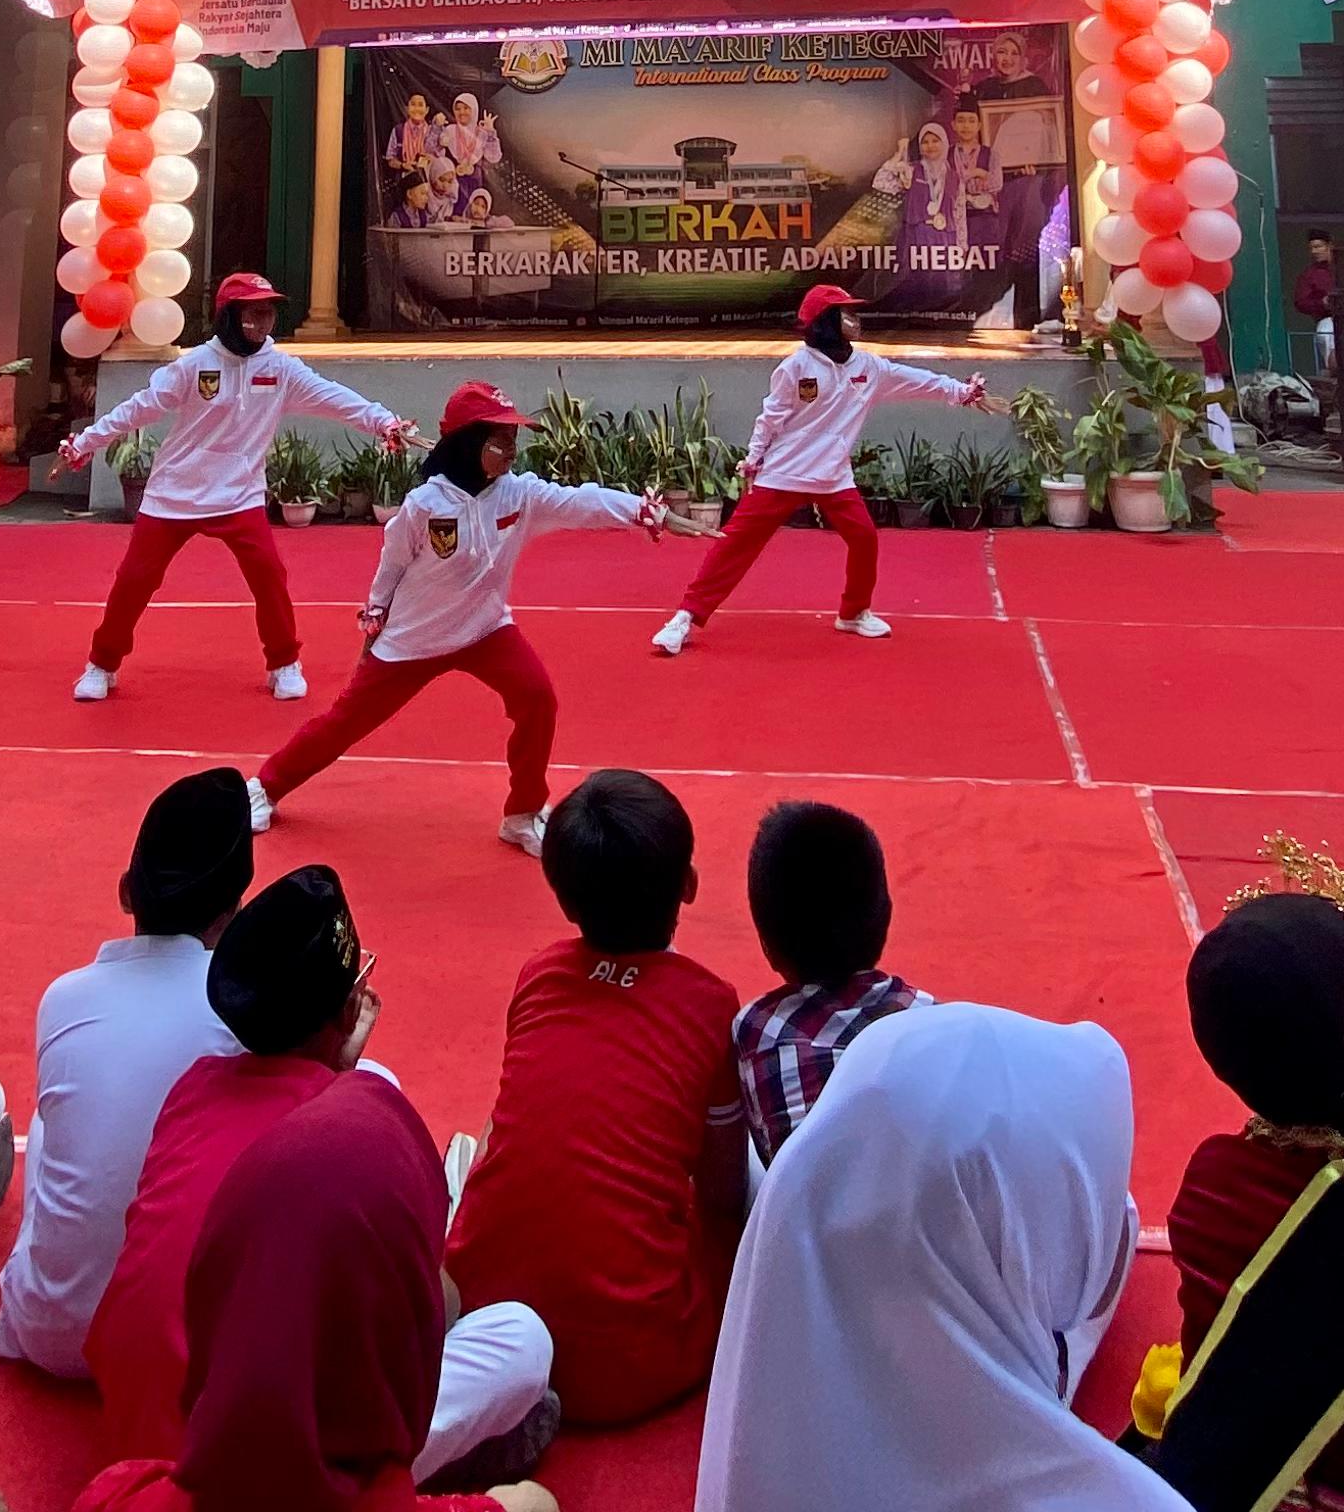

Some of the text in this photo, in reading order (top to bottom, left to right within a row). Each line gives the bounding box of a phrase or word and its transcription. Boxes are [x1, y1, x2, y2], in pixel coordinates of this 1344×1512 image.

[247, 22, 270, 35] Maju
[580, 38, 625, 66] MI
[780, 29, 944, 61] KETEGAN
[633, 61, 889, 88] International Class Program
[601, 202, 812, 243] BERKAH
[445, 244, 1000, 276] BERKARAKTER, KREATIF, ADAPTIF, HEBAT
[588, 960, 639, 988] ALE
